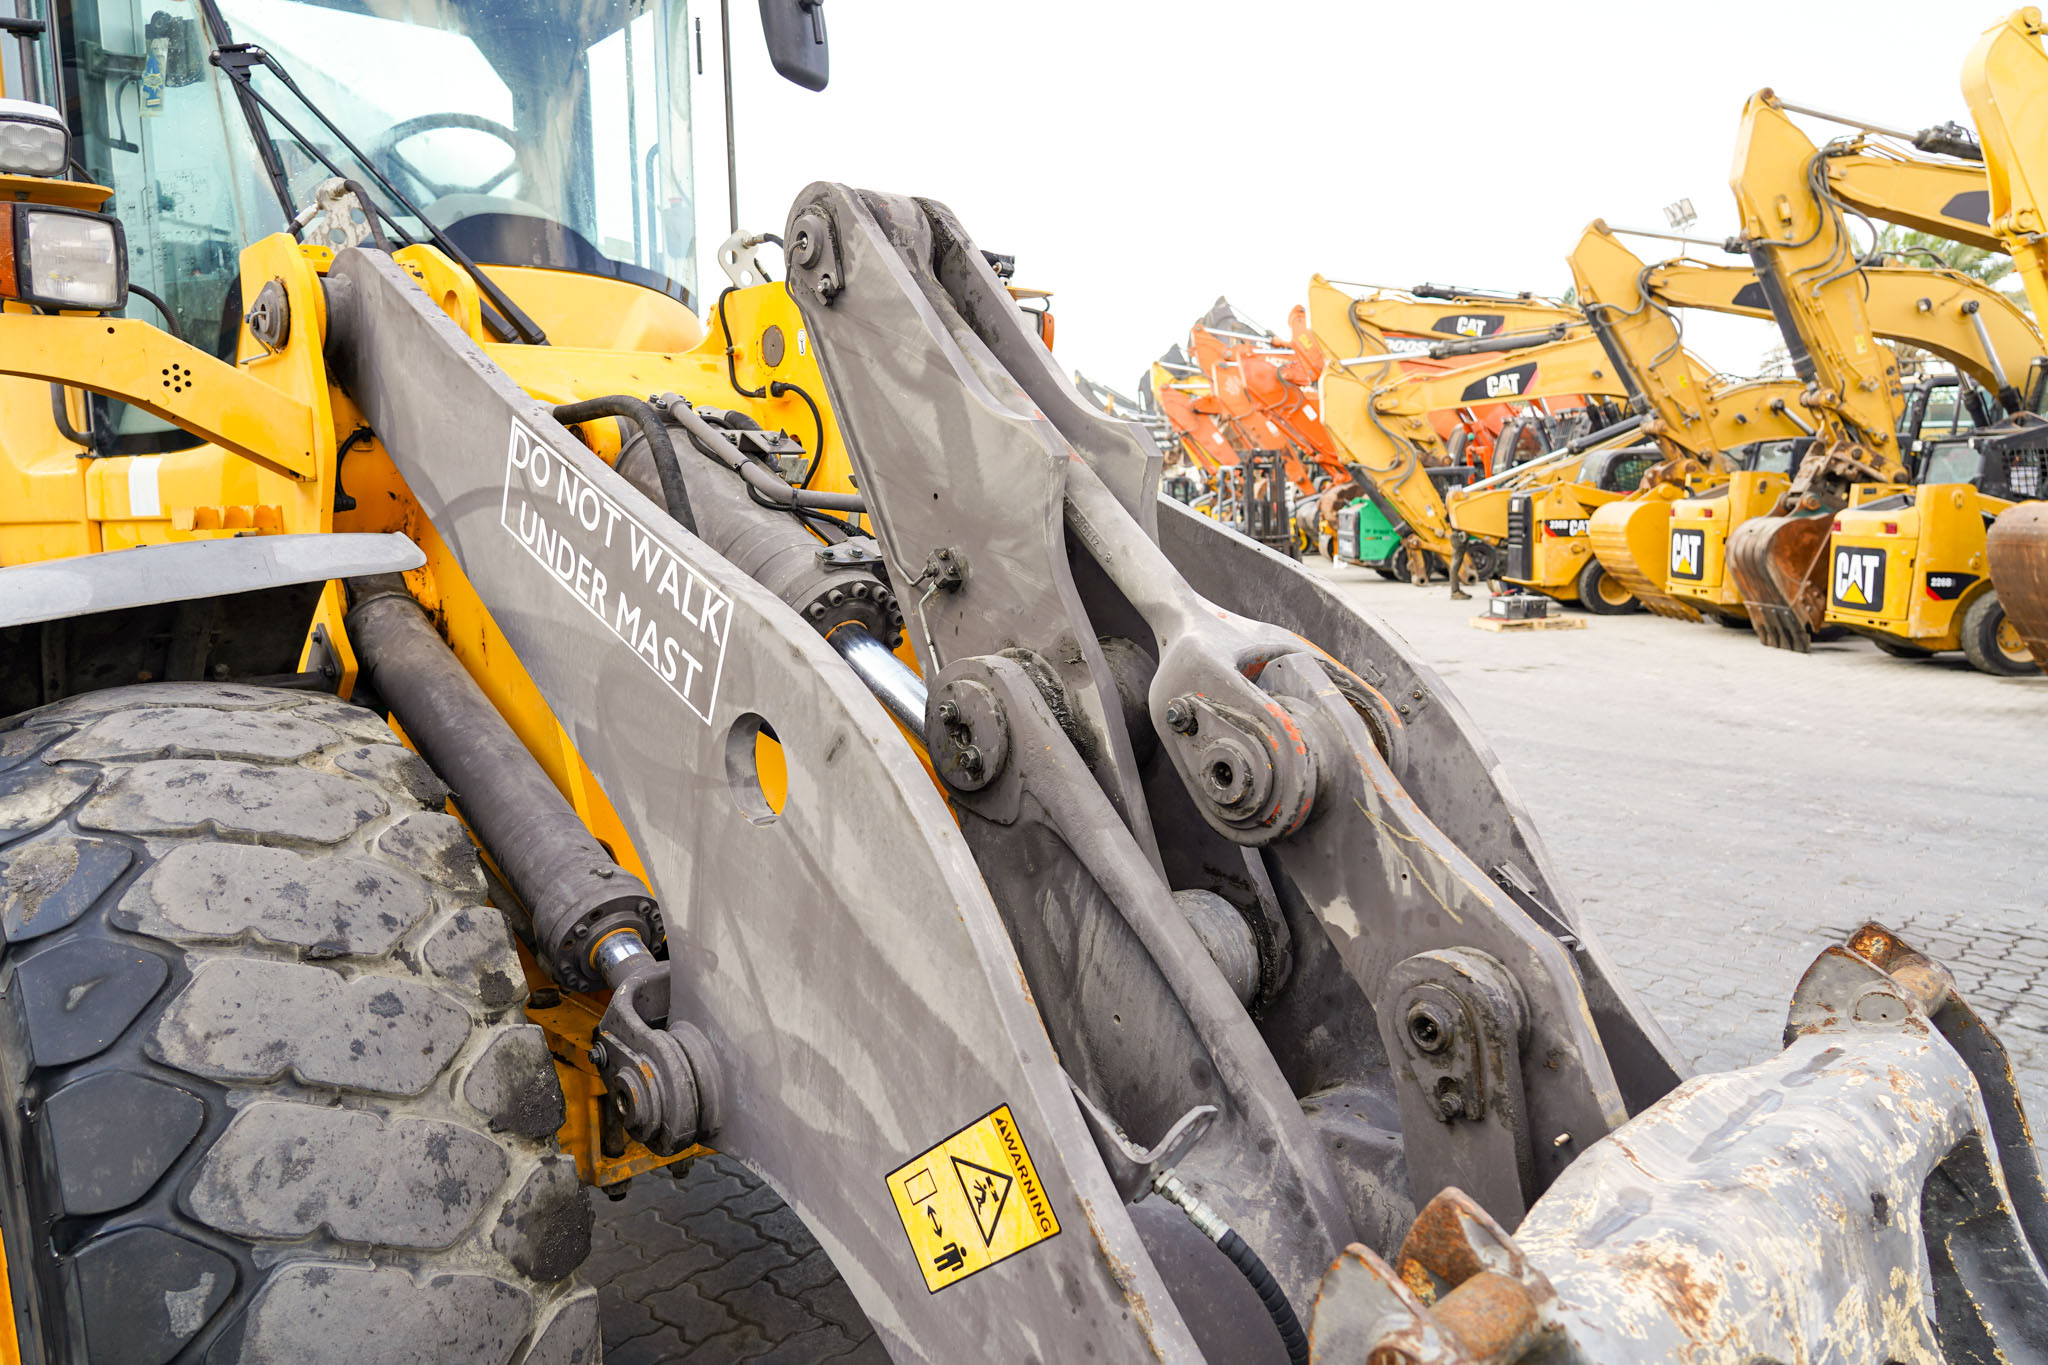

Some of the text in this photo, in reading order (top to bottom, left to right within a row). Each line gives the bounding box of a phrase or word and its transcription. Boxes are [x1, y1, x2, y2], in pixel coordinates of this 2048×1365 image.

[1456, 316, 1487, 337] CAT
[1486, 373, 1520, 397] CAT
[511, 429, 725, 647] DO NOT WALK
[1672, 533, 1701, 575] CAT
[519, 500, 703, 699] UNDER MAST
[1835, 551, 1880, 604] CAT
[1003, 1131, 1052, 1233] WARNING
